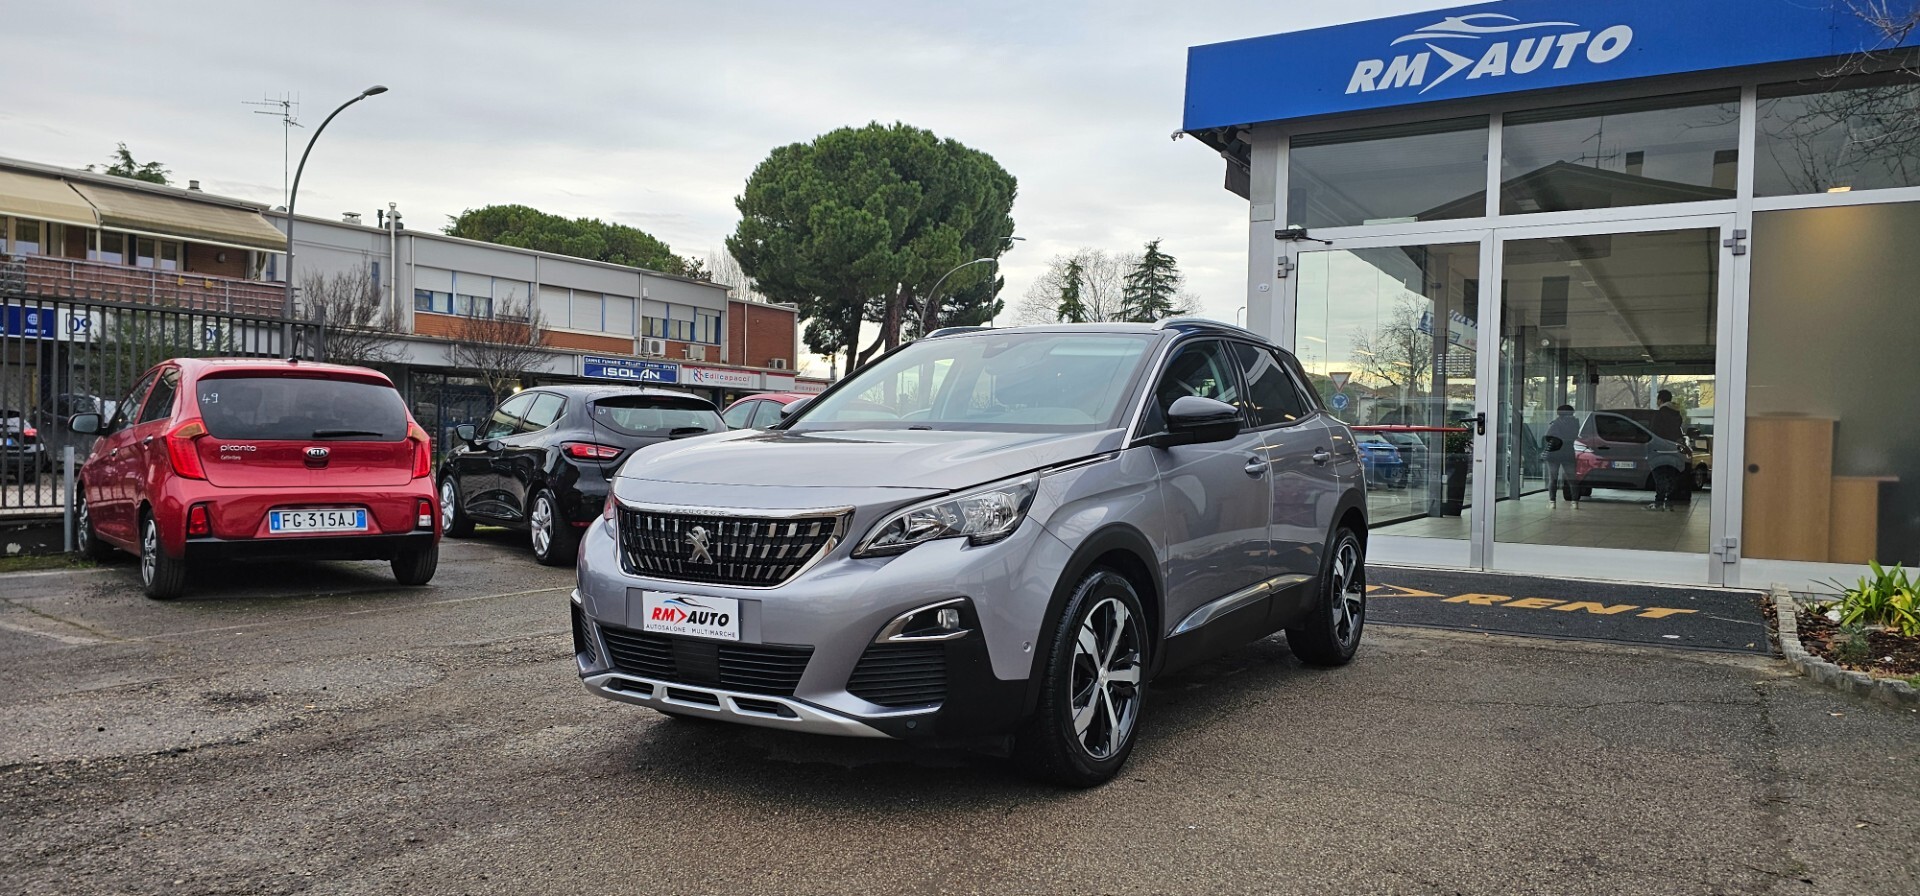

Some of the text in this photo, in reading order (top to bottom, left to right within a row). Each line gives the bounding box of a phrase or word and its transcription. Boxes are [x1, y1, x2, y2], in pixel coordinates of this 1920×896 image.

[1345, 24, 1633, 94] RM AUTO
[603, 367, 660, 381] ISOLAN
[202, 393, 218, 404] 49
[220, 444, 257, 452] picanto
[1441, 593, 1700, 619] RENT
[651, 607, 729, 627] RM AUTO
[646, 623, 736, 638] AUTOSALONE MULTIMARCHE
